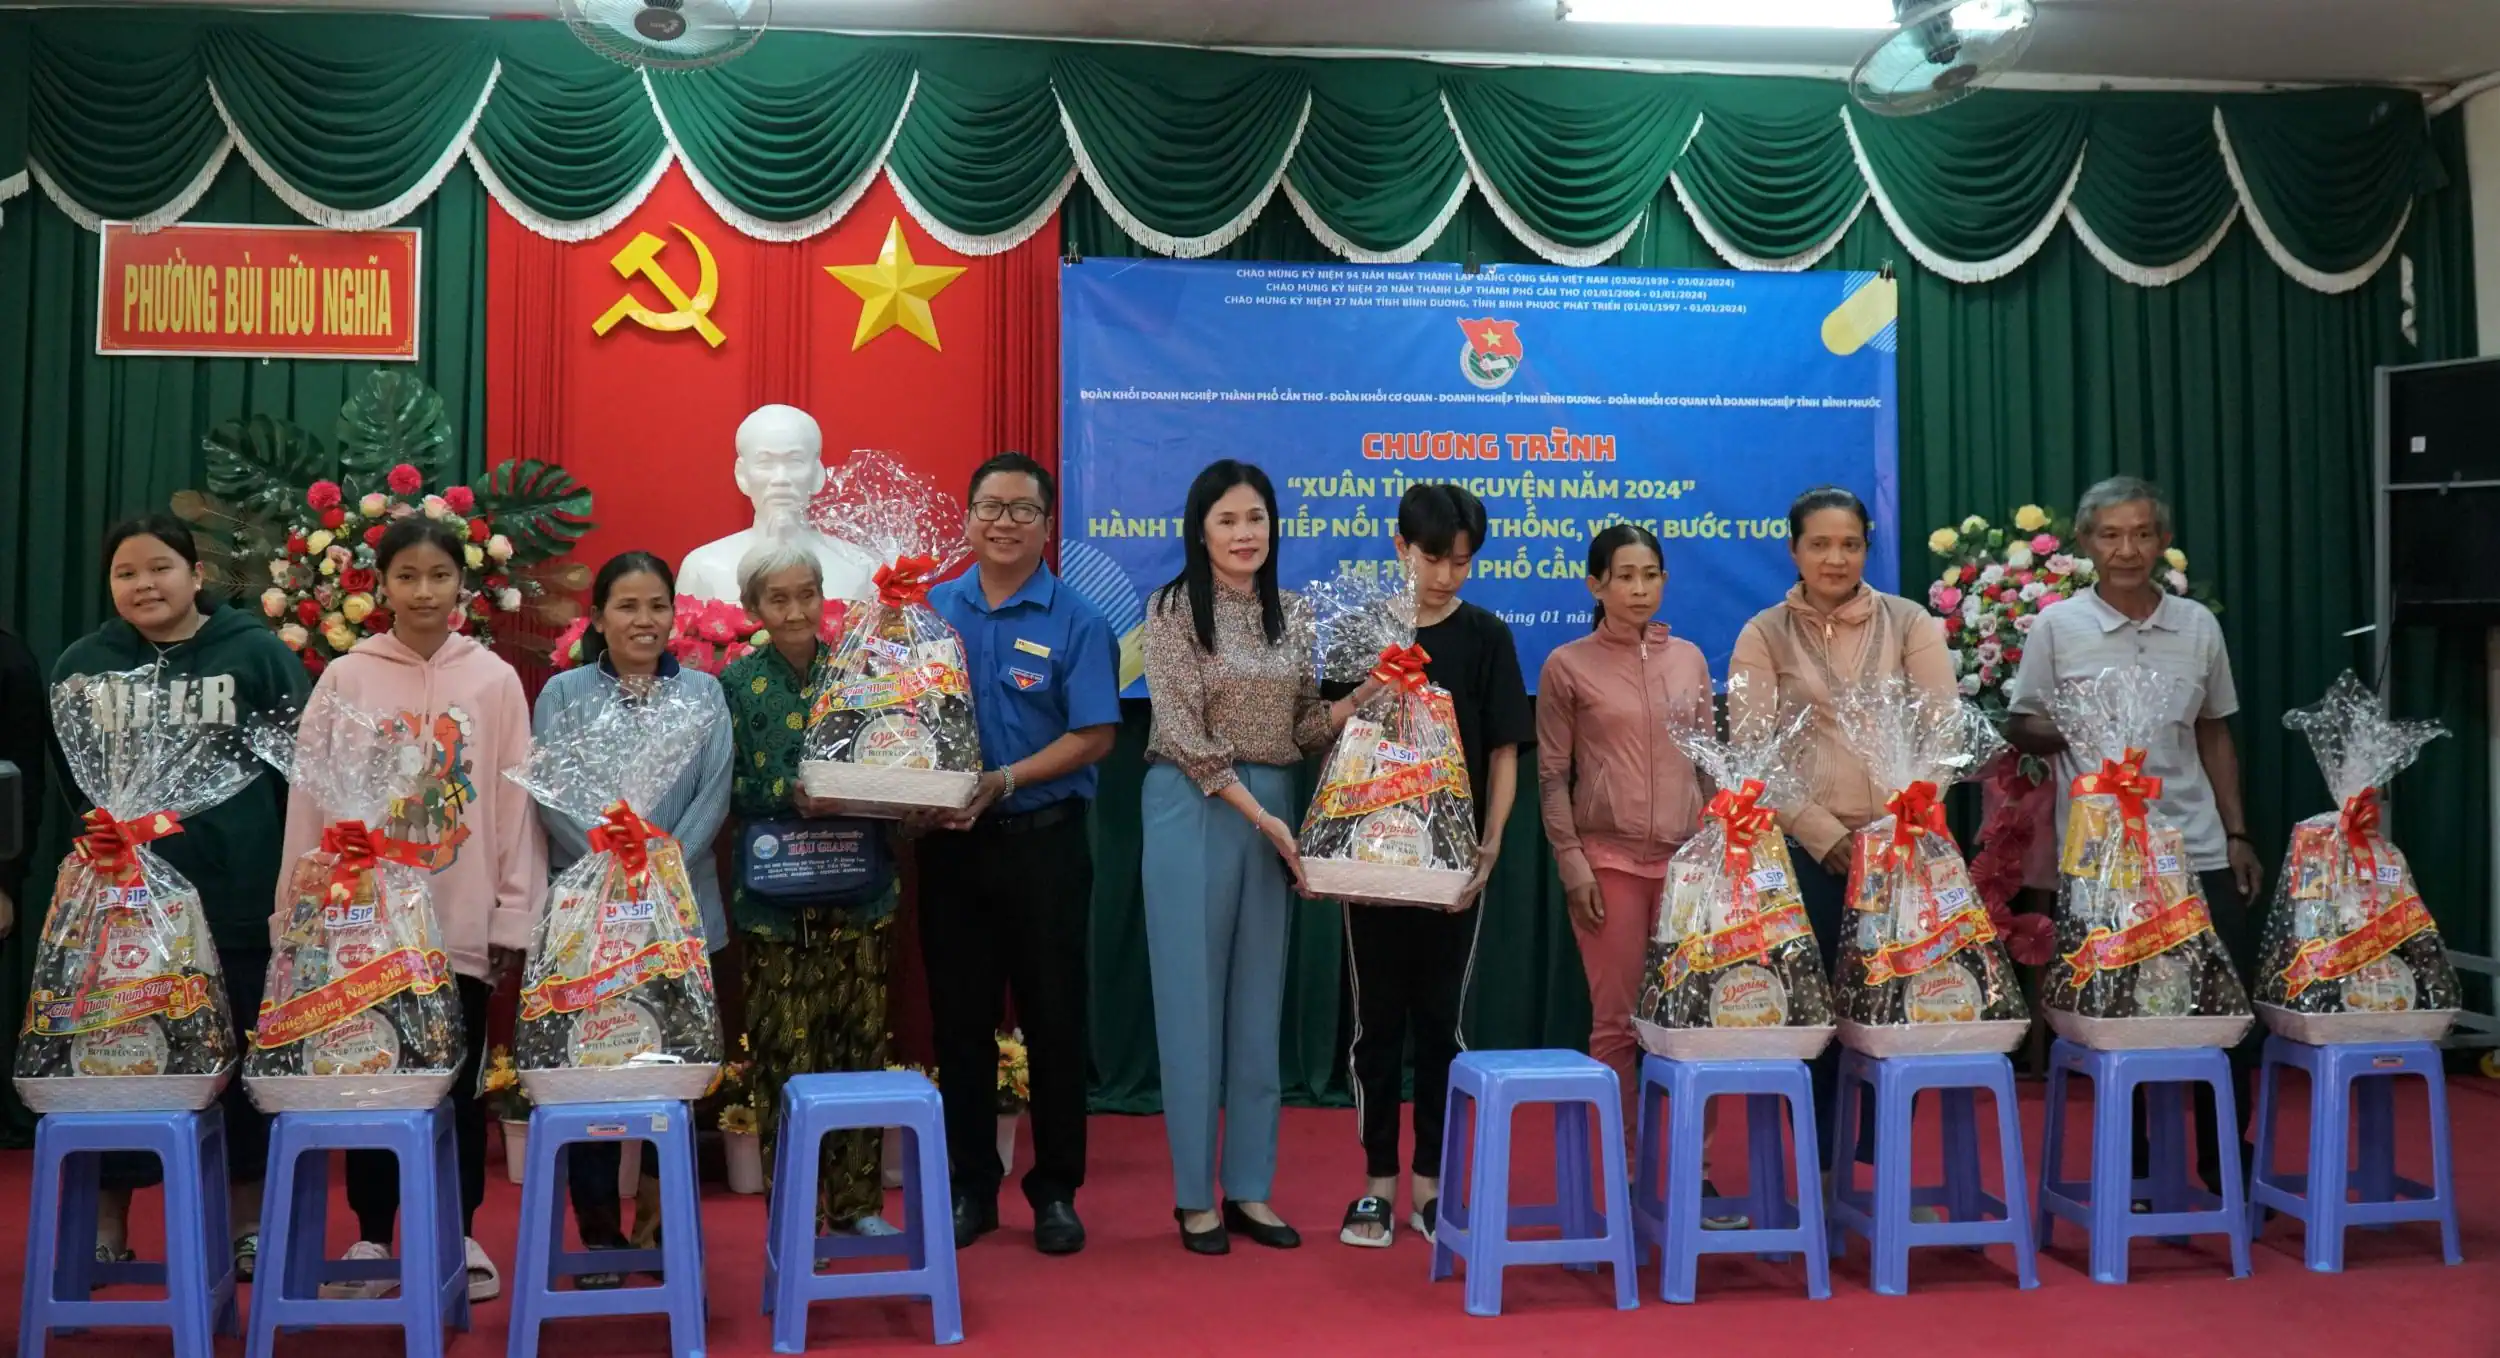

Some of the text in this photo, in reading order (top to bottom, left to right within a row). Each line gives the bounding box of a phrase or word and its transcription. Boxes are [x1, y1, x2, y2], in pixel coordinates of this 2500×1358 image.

[1318, 270, 1343, 280] NIỆM
[1346, 271, 1359, 280] 94
[1586, 276, 1608, 285] NAM
[123, 247, 393, 336] PHƯỜNG BÙI HỮU NGHĨA
[1347, 284, 1373, 295] NIỆM
[1376, 285, 1388, 293] 20
[1649, 290, 1708, 300] 01/01/2024)
[1306, 296, 1332, 307] NIỆM
[1334, 298, 1346, 306] 27
[1623, 302, 1680, 313] (01/01/1997
[1689, 304, 1747, 314] 01/01/2024)
[1080, 388, 1111, 400] ĐOÀN
[1112, 386, 1140, 400] KHỐI
[1141, 391, 1179, 400] DOANH
[1180, 389, 1218, 403] NGHIỆP
[1220, 388, 1255, 400] THÀNH
[1256, 387, 1278, 401] PHỐ
[1280, 388, 1300, 401] CẦN
[1302, 391, 1323, 401] THƠ
[1329, 390, 1360, 402] ĐOÀN
[1361, 388, 1386, 402] KHỐI
[1388, 392, 1402, 402] CƠ
[1403, 393, 1432, 403] QUAN
[1439, 393, 1476, 403] DOANH
[1476, 392, 1513, 406] NGHIỆP
[1514, 392, 1539, 404] TỈNH
[1540, 392, 1565, 404] BÌNH
[1566, 394, 1601, 404] DƯƠNG
[1608, 393, 1636, 405] ĐOÀN
[1638, 392, 1663, 406] KHỐI
[1664, 395, 1678, 406] CƠ
[1679, 396, 1708, 406] QUAN
[1708, 394, 1722, 407] VÀ
[1724, 397, 1759, 407] DOANH
[1760, 395, 1795, 410] NGHIỆP
[1796, 396, 1820, 408] TỈNH
[1822, 396, 1846, 408] BÌNH
[1848, 396, 1882, 408] PHƯỚC
[1362, 430, 1500, 461] CHƯƠNG
[1451, 470, 1555, 504] NGUYỆN
[1560, 470, 1619, 499] NĂM
[1624, 478, 1696, 500] 2024”
[1088, 508, 1166, 538] HÀNH
[1332, 504, 1379, 538] NỐI
[1488, 502, 1584, 542] THỐNG,
[1663, 511, 1732, 539] BƯỚC
[1736, 517, 1792, 540] TƯƠ
[1478, 545, 1532, 580] PHỐ
[1536, 546, 1586, 580] CẦN
[1495, 610, 1536, 626] háng
[1540, 610, 1559, 624] 01
[2157, 858, 2177, 870] SIP
[2378, 867, 2399, 879] SIP
[345, 907, 374, 921] SIP
[49, 1002, 72, 1018] Chú
